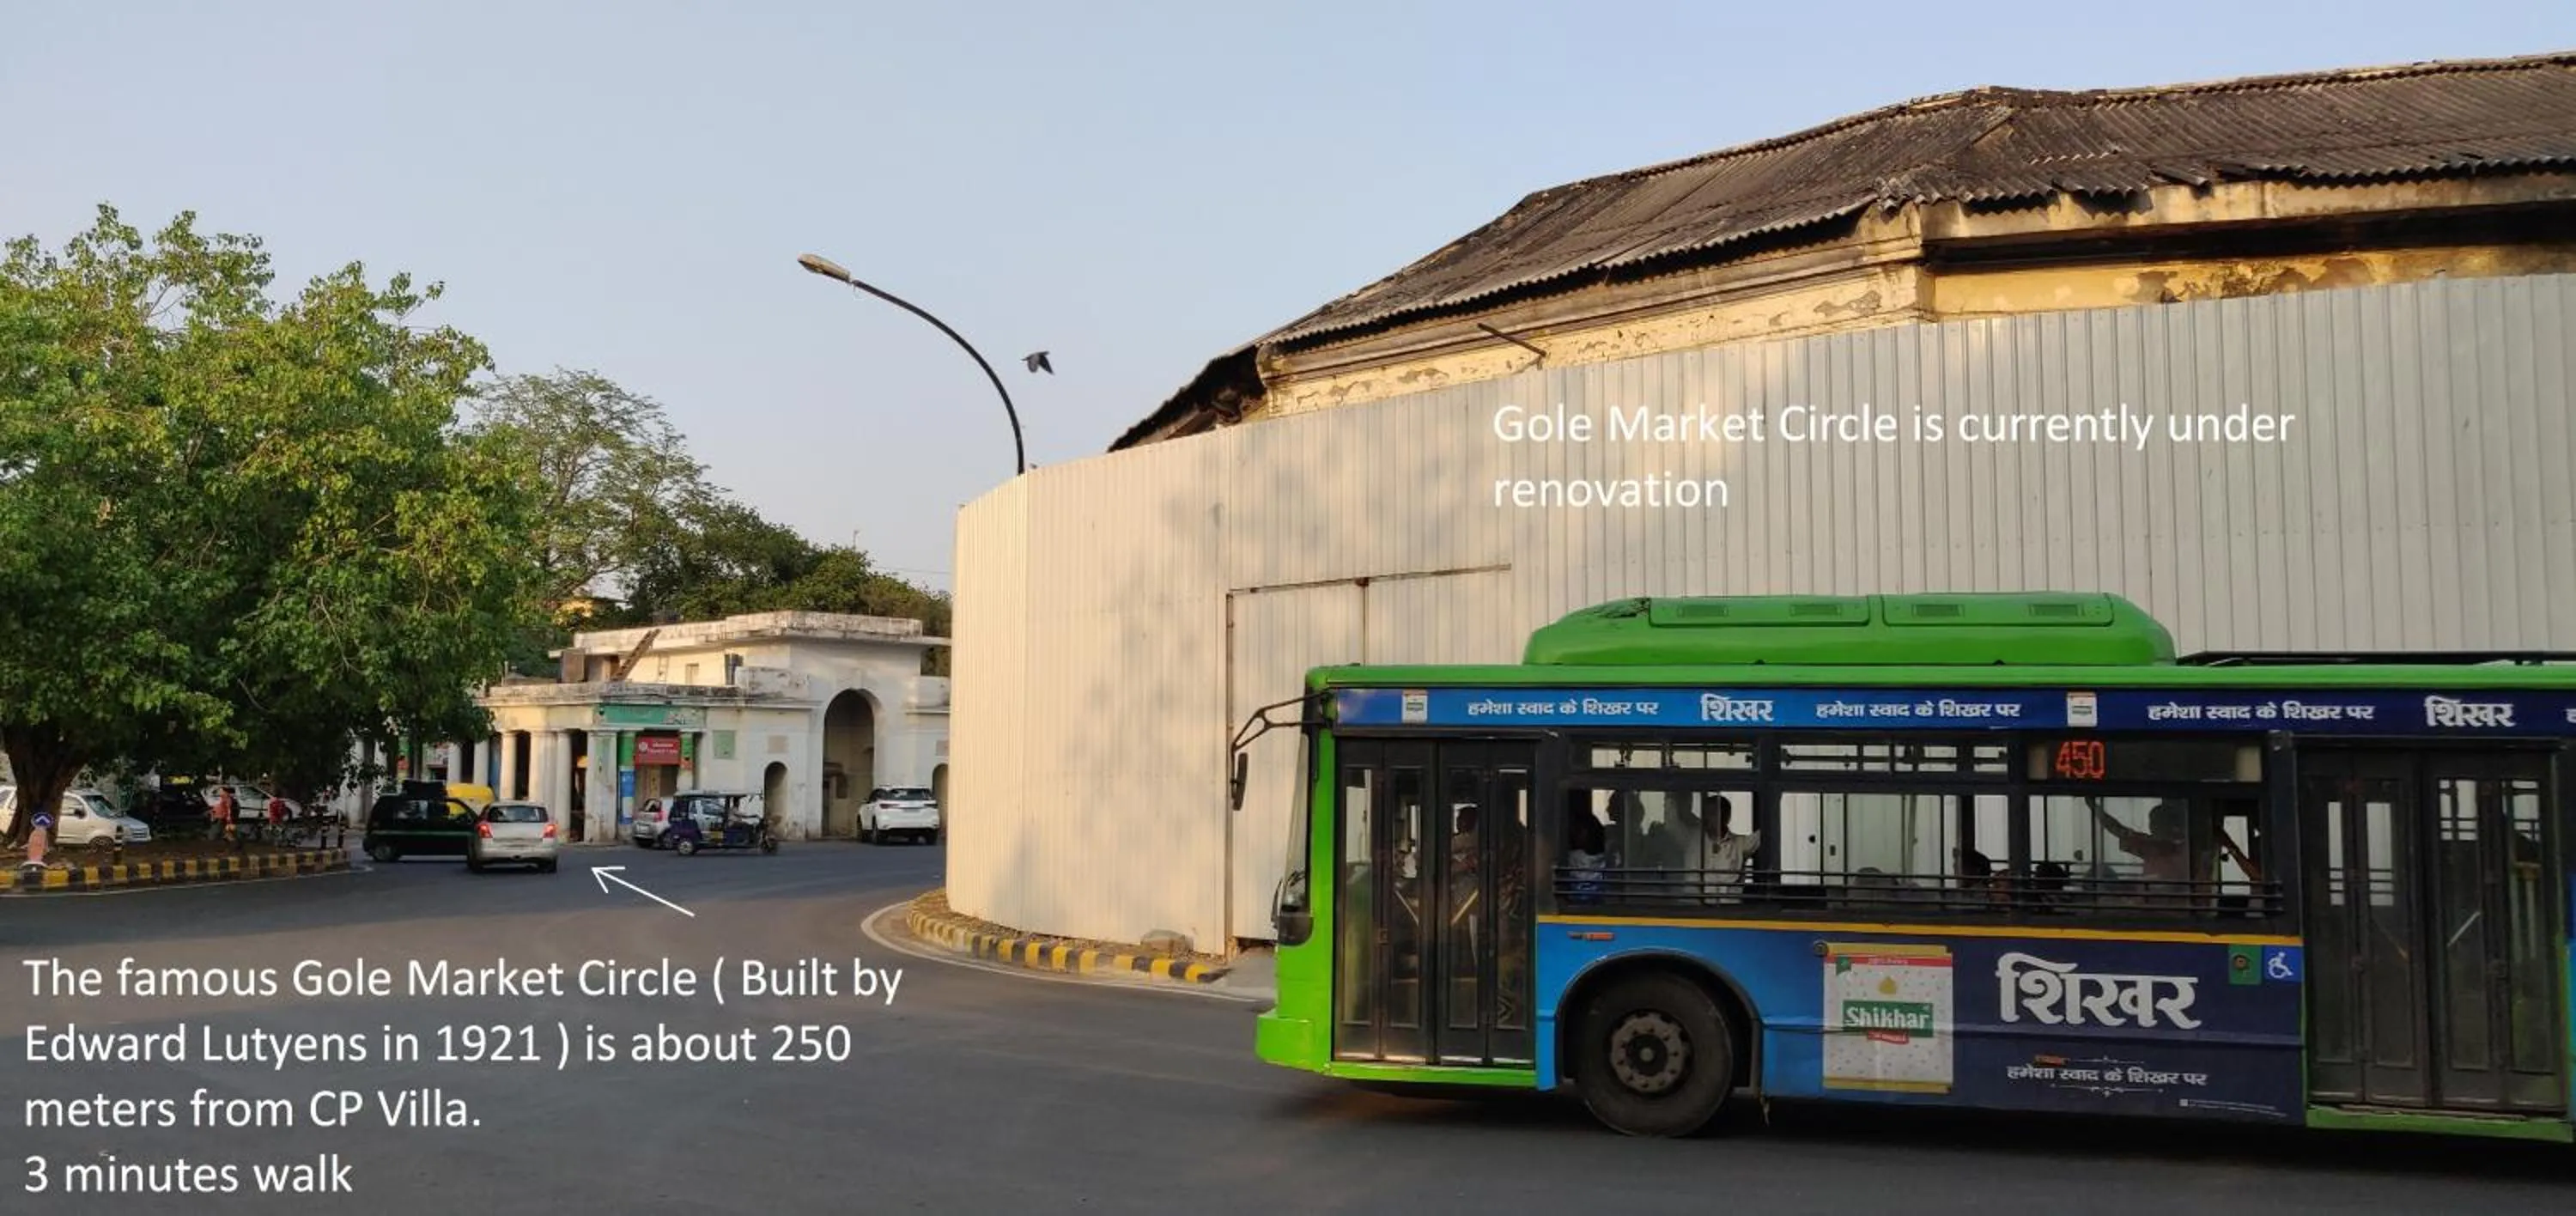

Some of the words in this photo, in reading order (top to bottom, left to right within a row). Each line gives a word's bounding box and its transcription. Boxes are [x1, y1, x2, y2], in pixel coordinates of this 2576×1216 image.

[1467, 698, 1513, 715] हमेशा
[1517, 702, 1554, 715] स्वाद
[1559, 698, 1577, 714] के
[1583, 697, 1631, 715] शिखर
[1637, 702, 1658, 715] पर
[1701, 693, 1774, 721] शिखर
[1816, 700, 1864, 717] हमेशा
[1869, 703, 1910, 717] स्वाद
[1915, 700, 1934, 716] के
[1939, 698, 1991, 718] शिखर
[1996, 703, 2020, 718] पर
[2147, 702, 2201, 720] हमेशा
[2206, 706, 2251, 720] स्वाद
[2256, 702, 2277, 720] के
[2281, 700, 2342, 720] शिखर
[2346, 706, 2376, 720] पर
[2424, 695, 2516, 727] शिखर
[2056, 739, 2105, 779] 450
[1995, 952, 2202, 1030] शिखर
[1844, 1006, 1929, 1029] Shikhar
[2007, 1064, 2056, 1079] हमेशा
[2059, 1068, 2099, 1081] स्वाद
[2104, 1067, 2123, 1082] के
[2127, 1065, 2179, 1085] शिखर
[2183, 1072, 2208, 1085] पर
